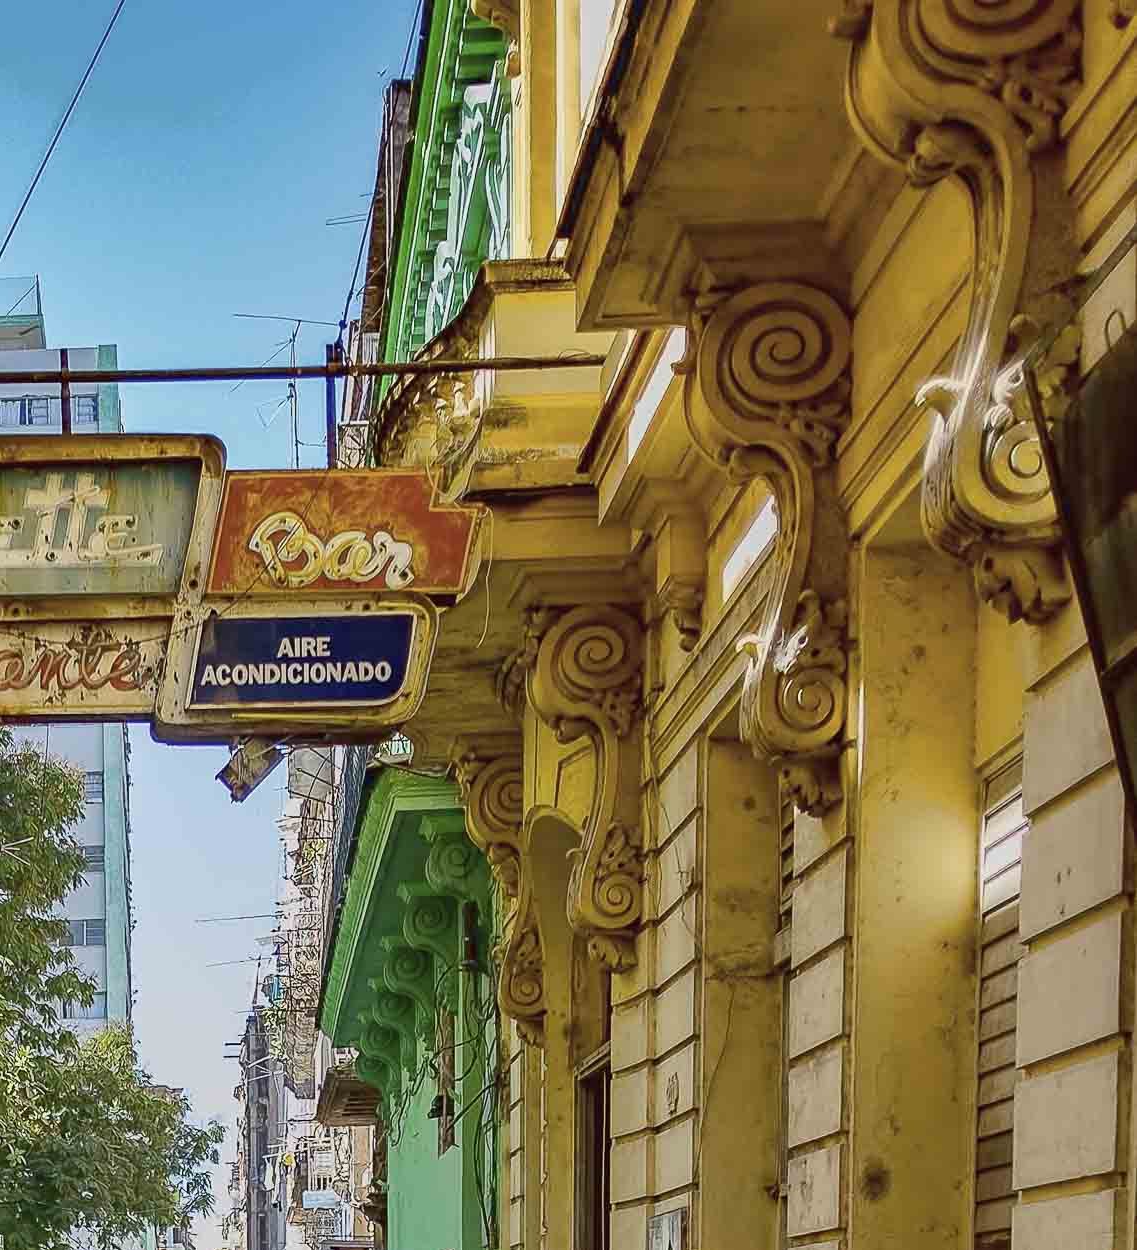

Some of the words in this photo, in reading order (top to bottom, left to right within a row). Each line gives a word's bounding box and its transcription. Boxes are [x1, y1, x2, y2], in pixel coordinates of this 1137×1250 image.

[249, 511, 414, 592] Bar
[277, 636, 331, 659] AIRE
[200, 660, 392, 687] ACONDICIONADO
